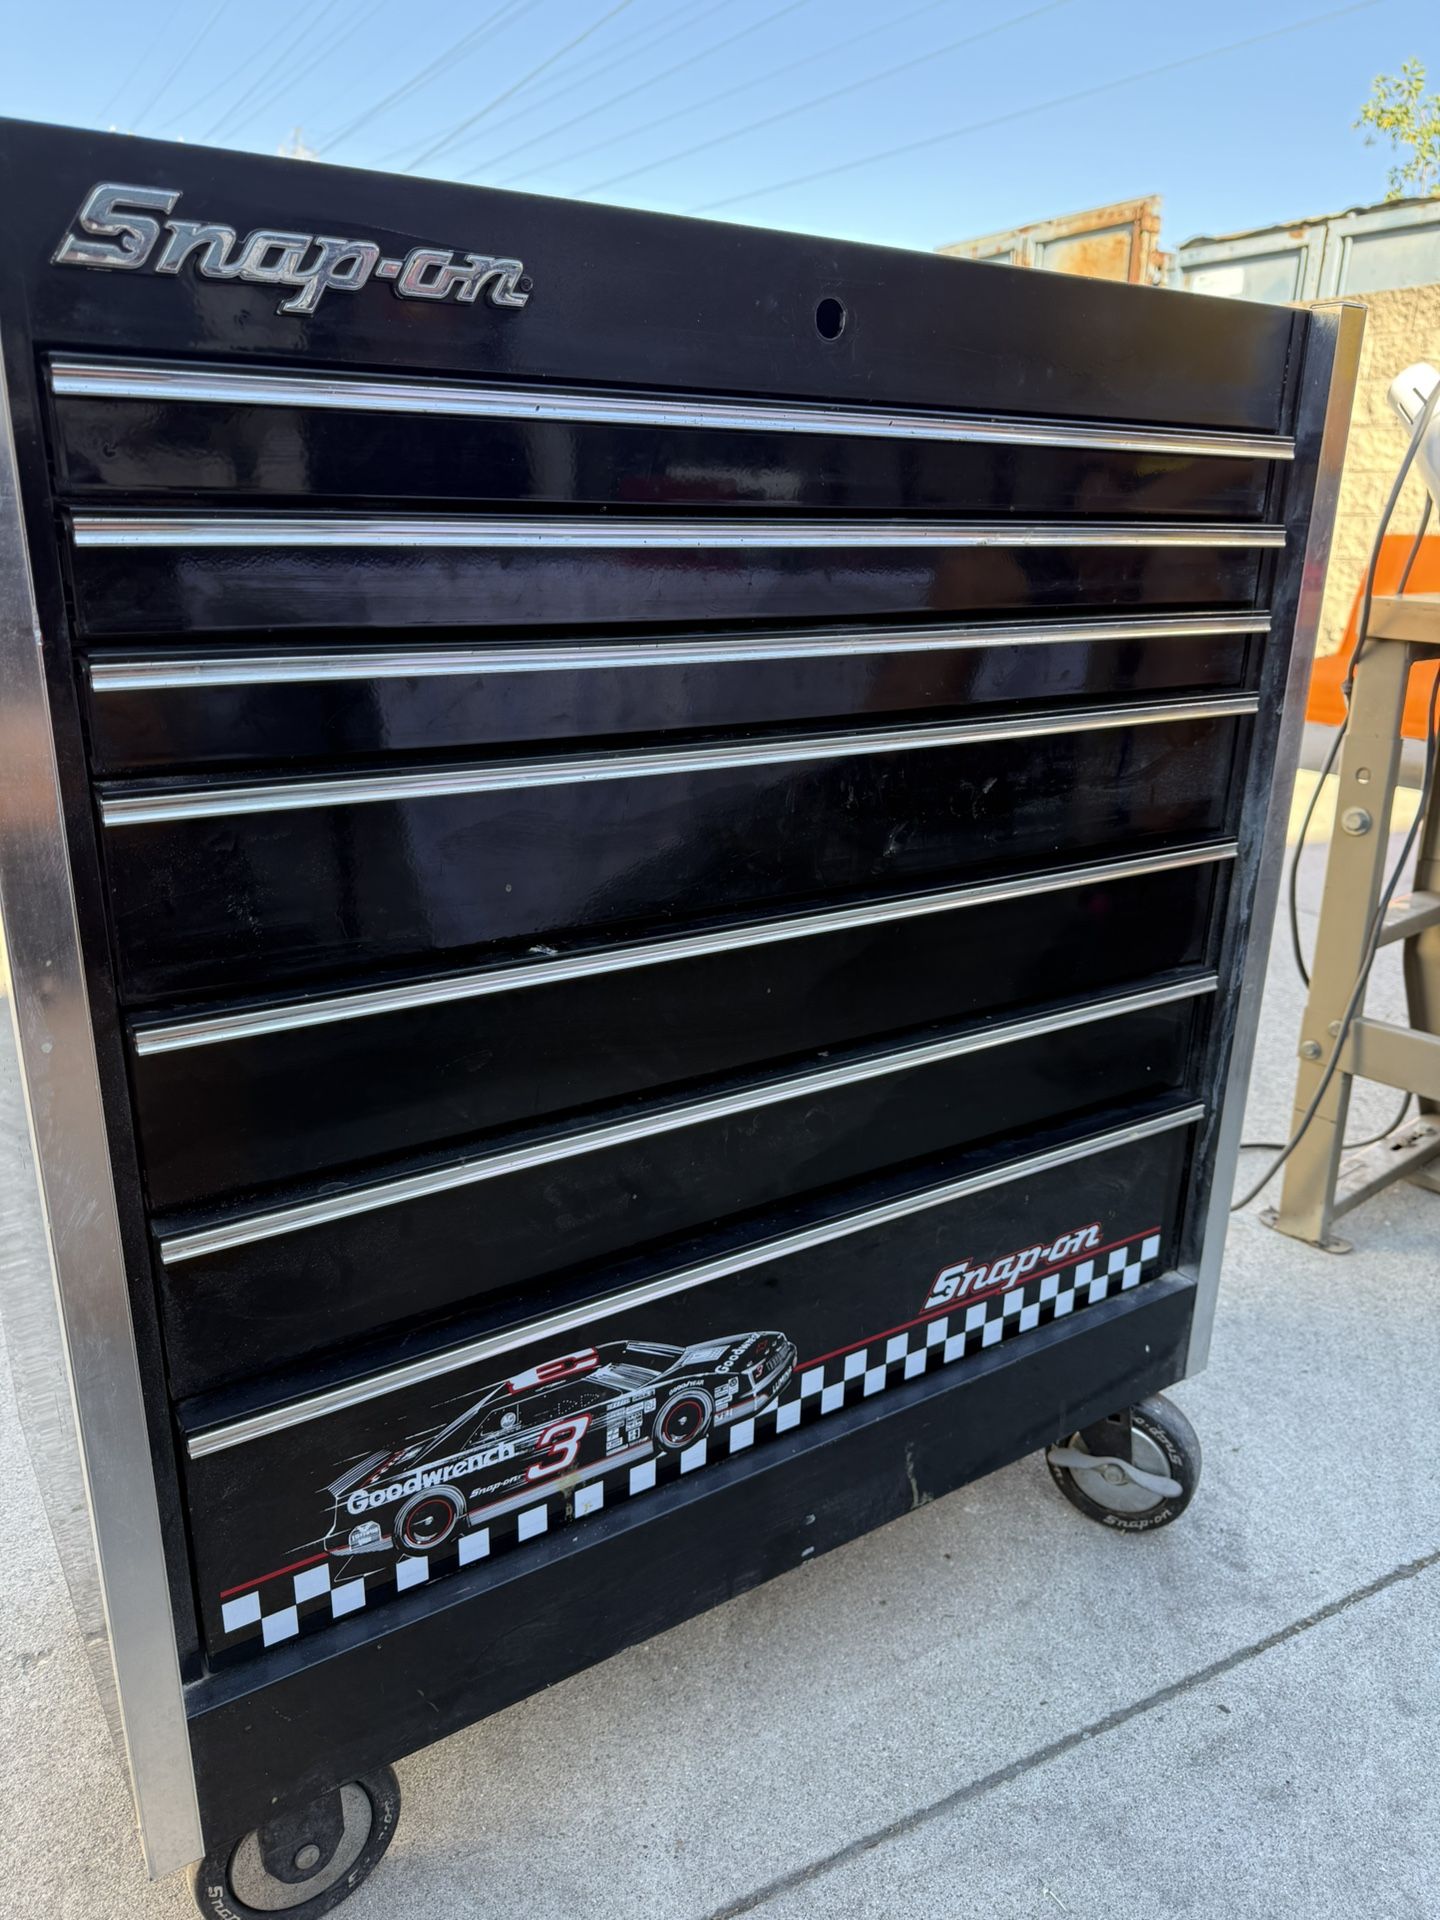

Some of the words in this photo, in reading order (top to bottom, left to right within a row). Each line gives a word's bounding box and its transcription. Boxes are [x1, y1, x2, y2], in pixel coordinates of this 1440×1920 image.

[51, 181, 532, 316] Snap-on
[921, 1223, 1103, 1312] Snap-on
[346, 1440, 517, 1515] Goodwrench
[525, 1413, 592, 1483] 3
[469, 1472, 525, 1500] Snap-on
[1103, 1508, 1173, 1530] Snap-on
